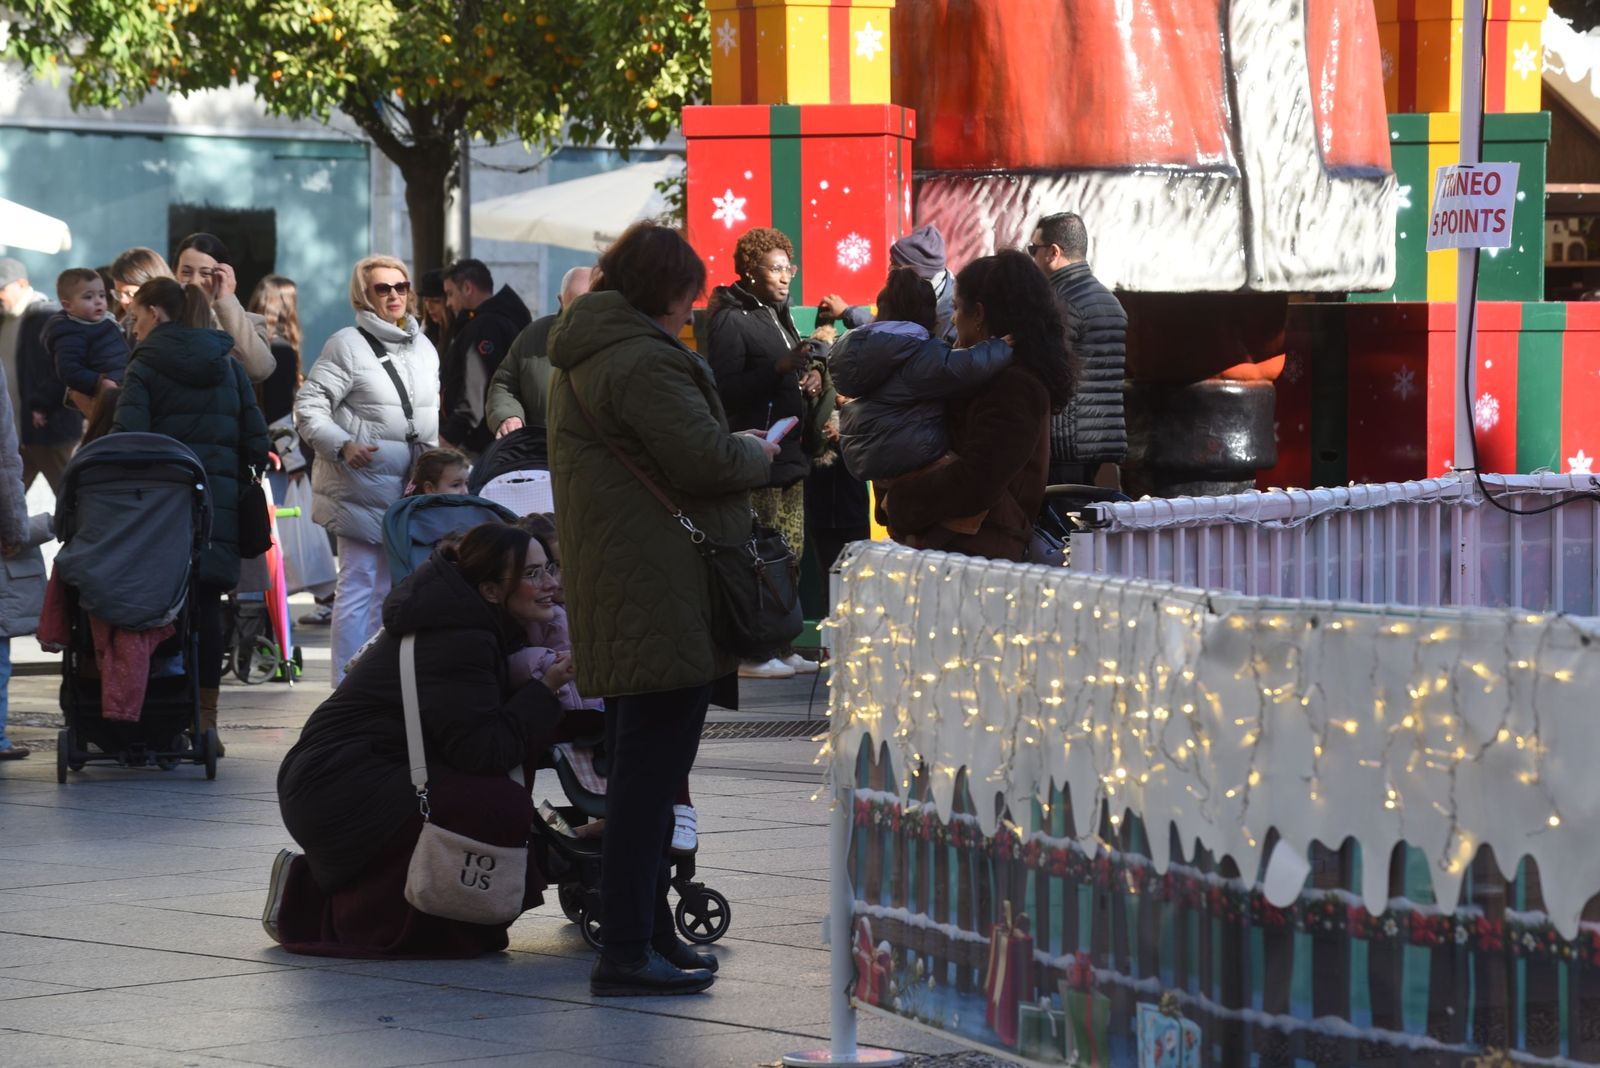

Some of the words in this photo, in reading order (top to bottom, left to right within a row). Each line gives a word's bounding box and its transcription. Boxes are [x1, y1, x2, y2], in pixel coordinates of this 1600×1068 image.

[1432, 213, 1440, 237] 5
[1440, 208, 1507, 235] POINTS
[463, 850, 496, 871] TO
[460, 869, 491, 891] US
